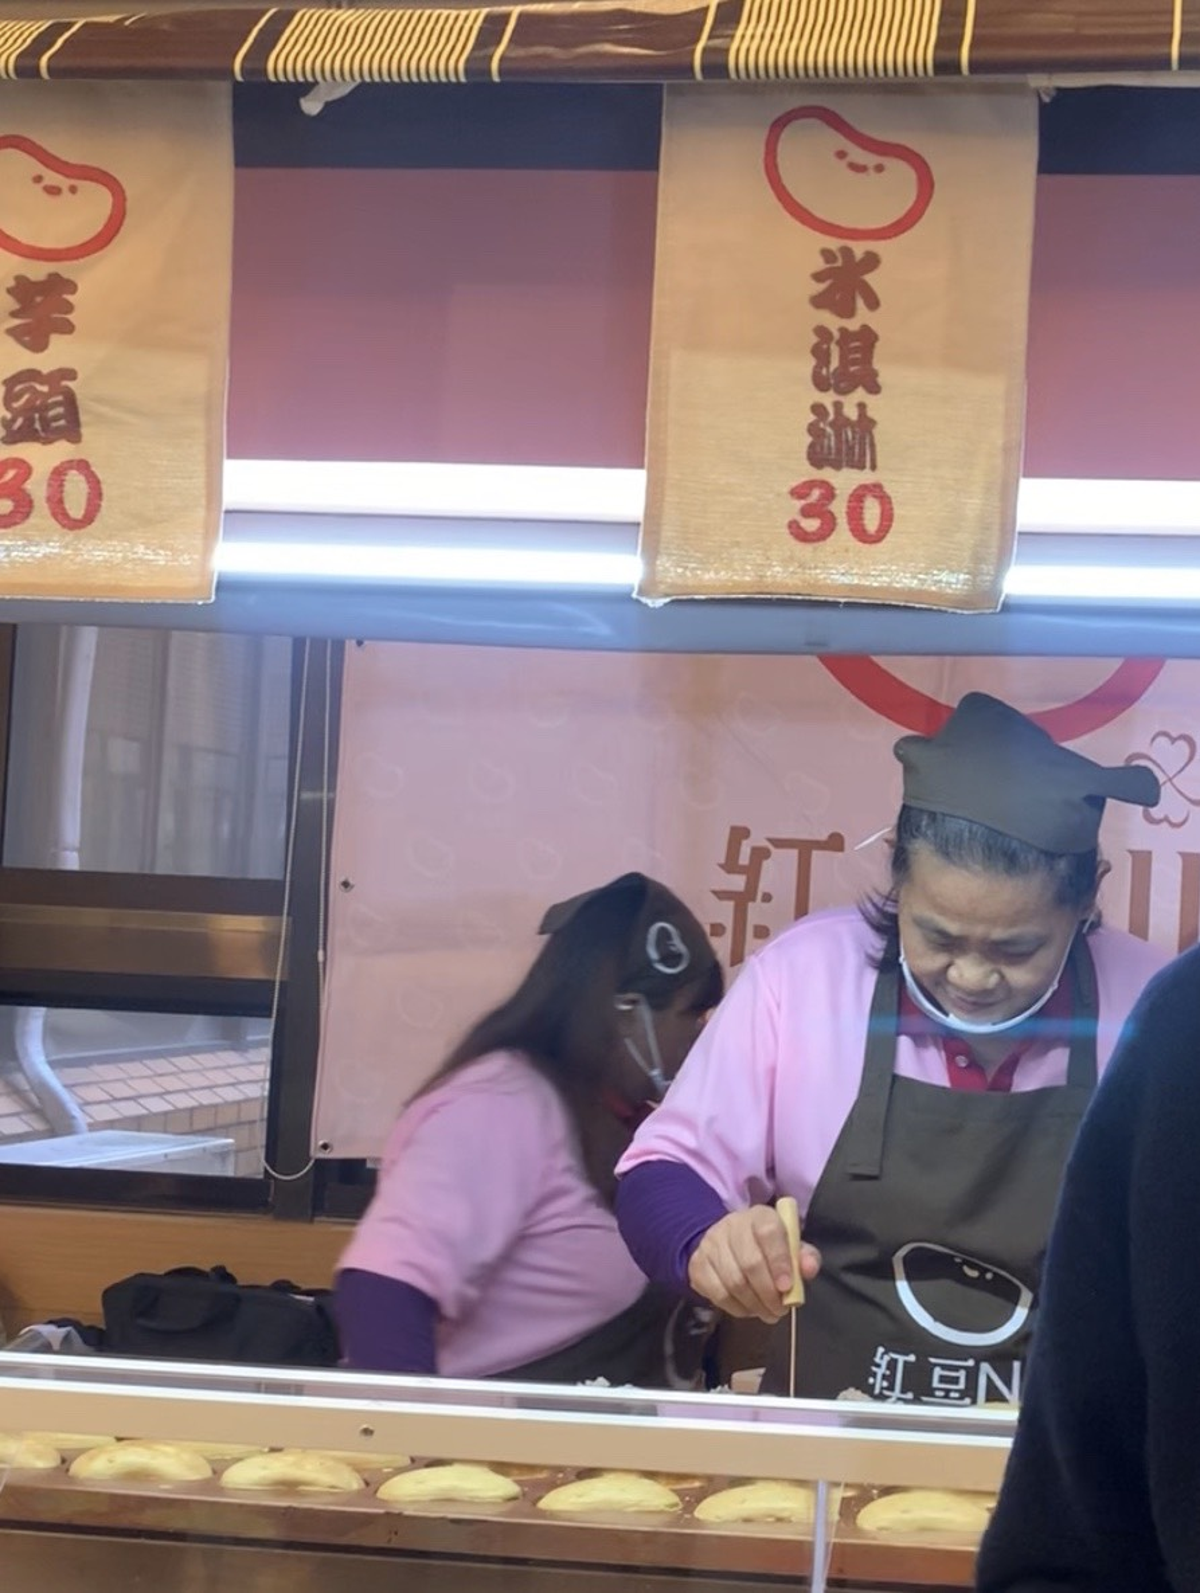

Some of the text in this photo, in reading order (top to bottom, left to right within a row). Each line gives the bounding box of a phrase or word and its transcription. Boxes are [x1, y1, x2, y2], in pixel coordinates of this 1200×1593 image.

[1, 272, 82, 446] 芋頭
[0, 457, 103, 531] 30
[787, 478, 895, 545] 30
